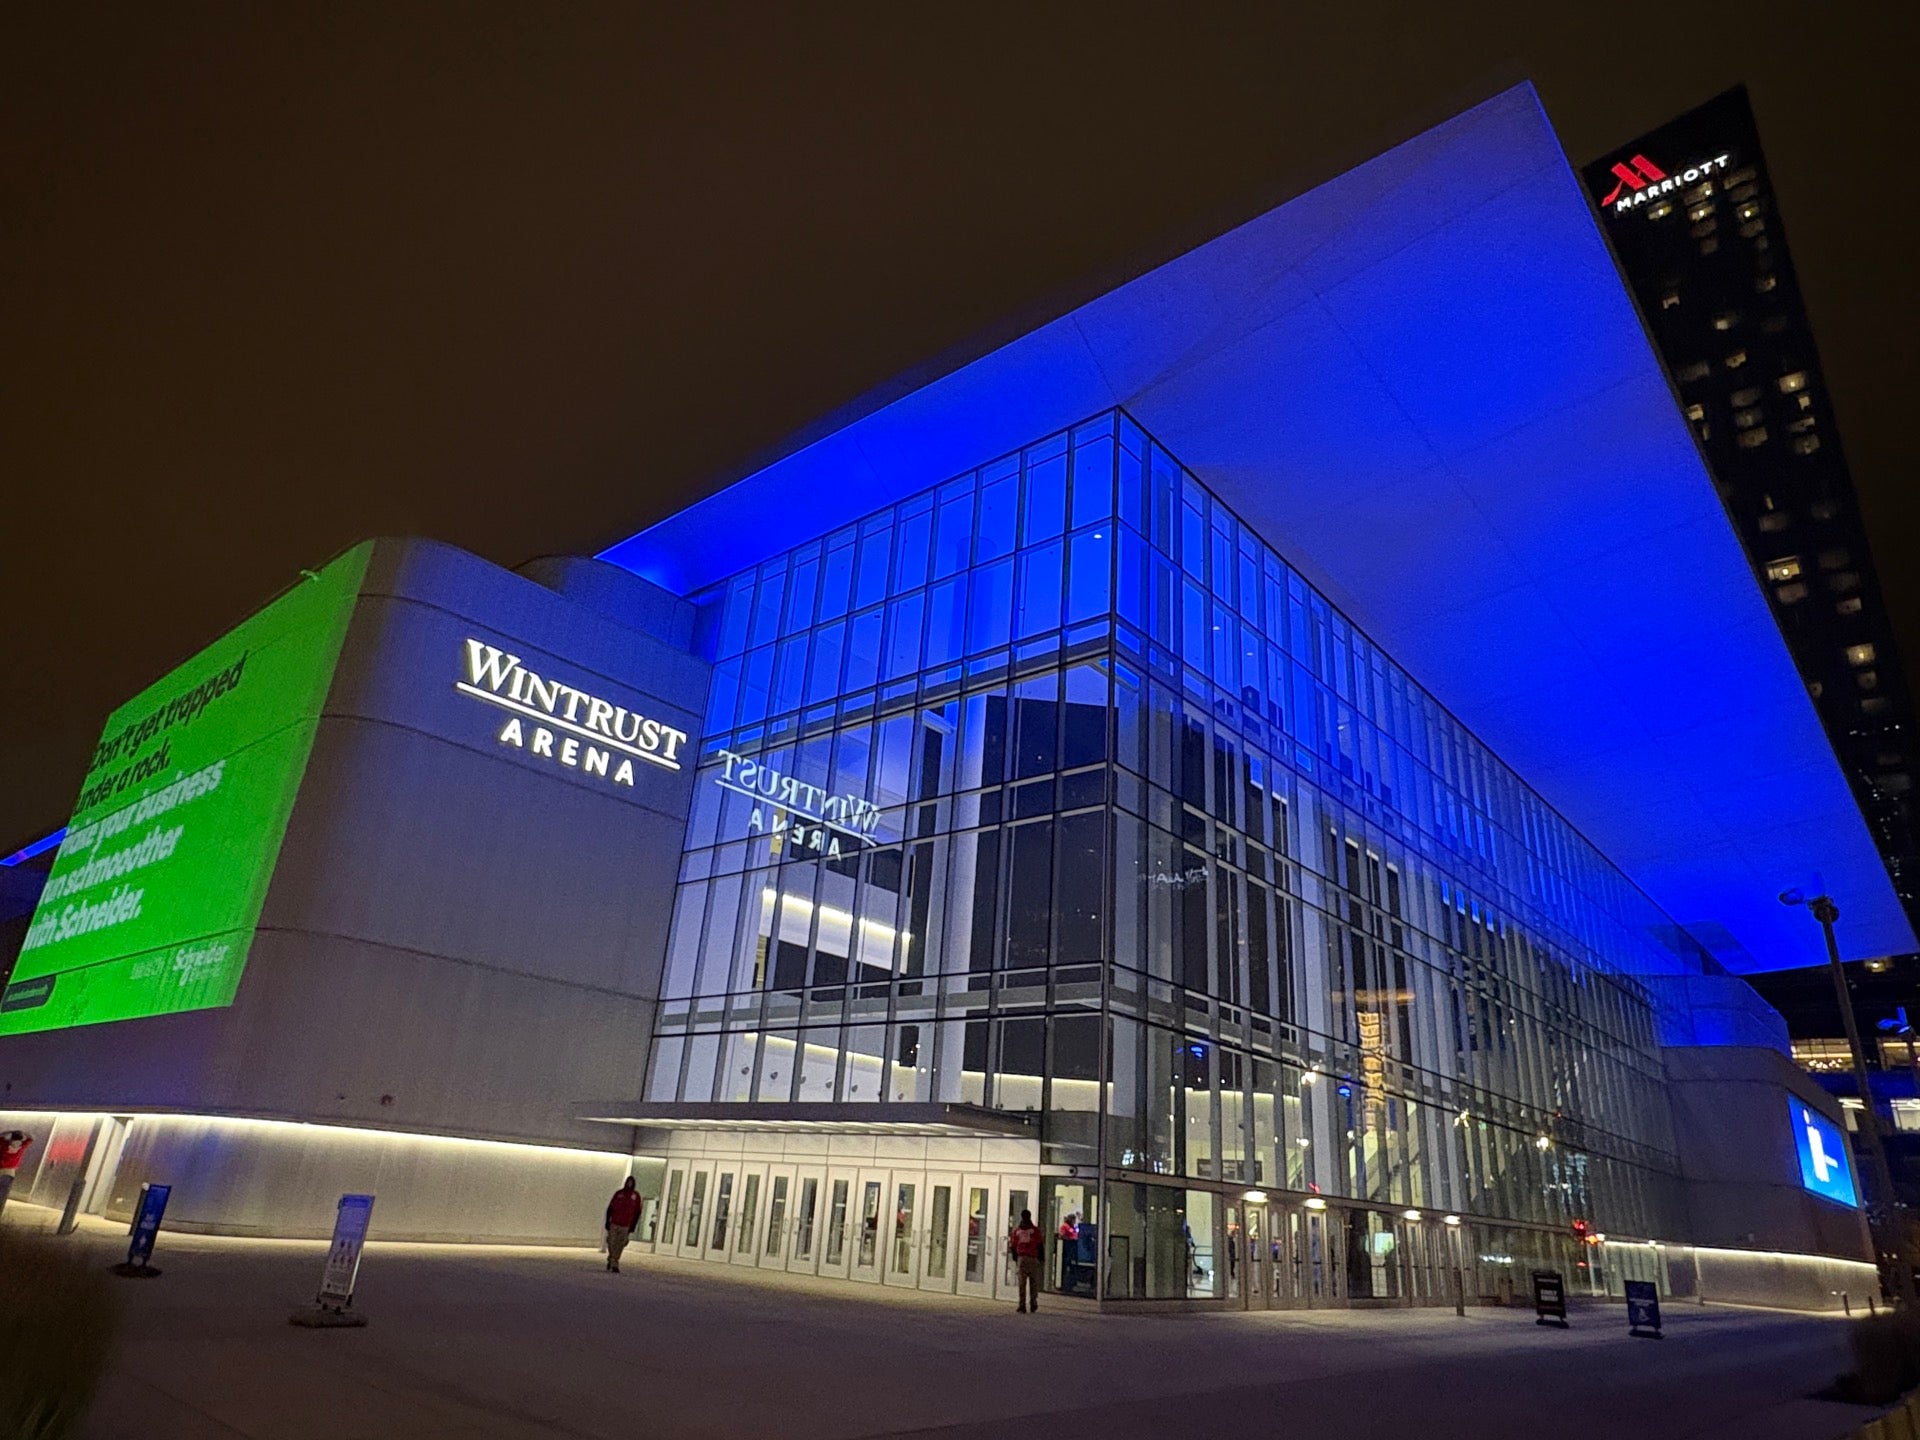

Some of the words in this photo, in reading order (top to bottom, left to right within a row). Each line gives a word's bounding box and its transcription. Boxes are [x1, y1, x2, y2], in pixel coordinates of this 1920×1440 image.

[1616, 154, 1729, 212] MARRIOTT
[129, 705, 166, 758] get
[163, 650, 248, 727] trapped
[466, 638, 688, 761] WINTRUST
[499, 718, 635, 787] ARENA
[72, 773, 119, 816] under
[116, 766, 131, 794] a
[88, 803, 138, 864] your
[134, 760, 225, 825] business
[54, 883, 144, 942] Schneider.
